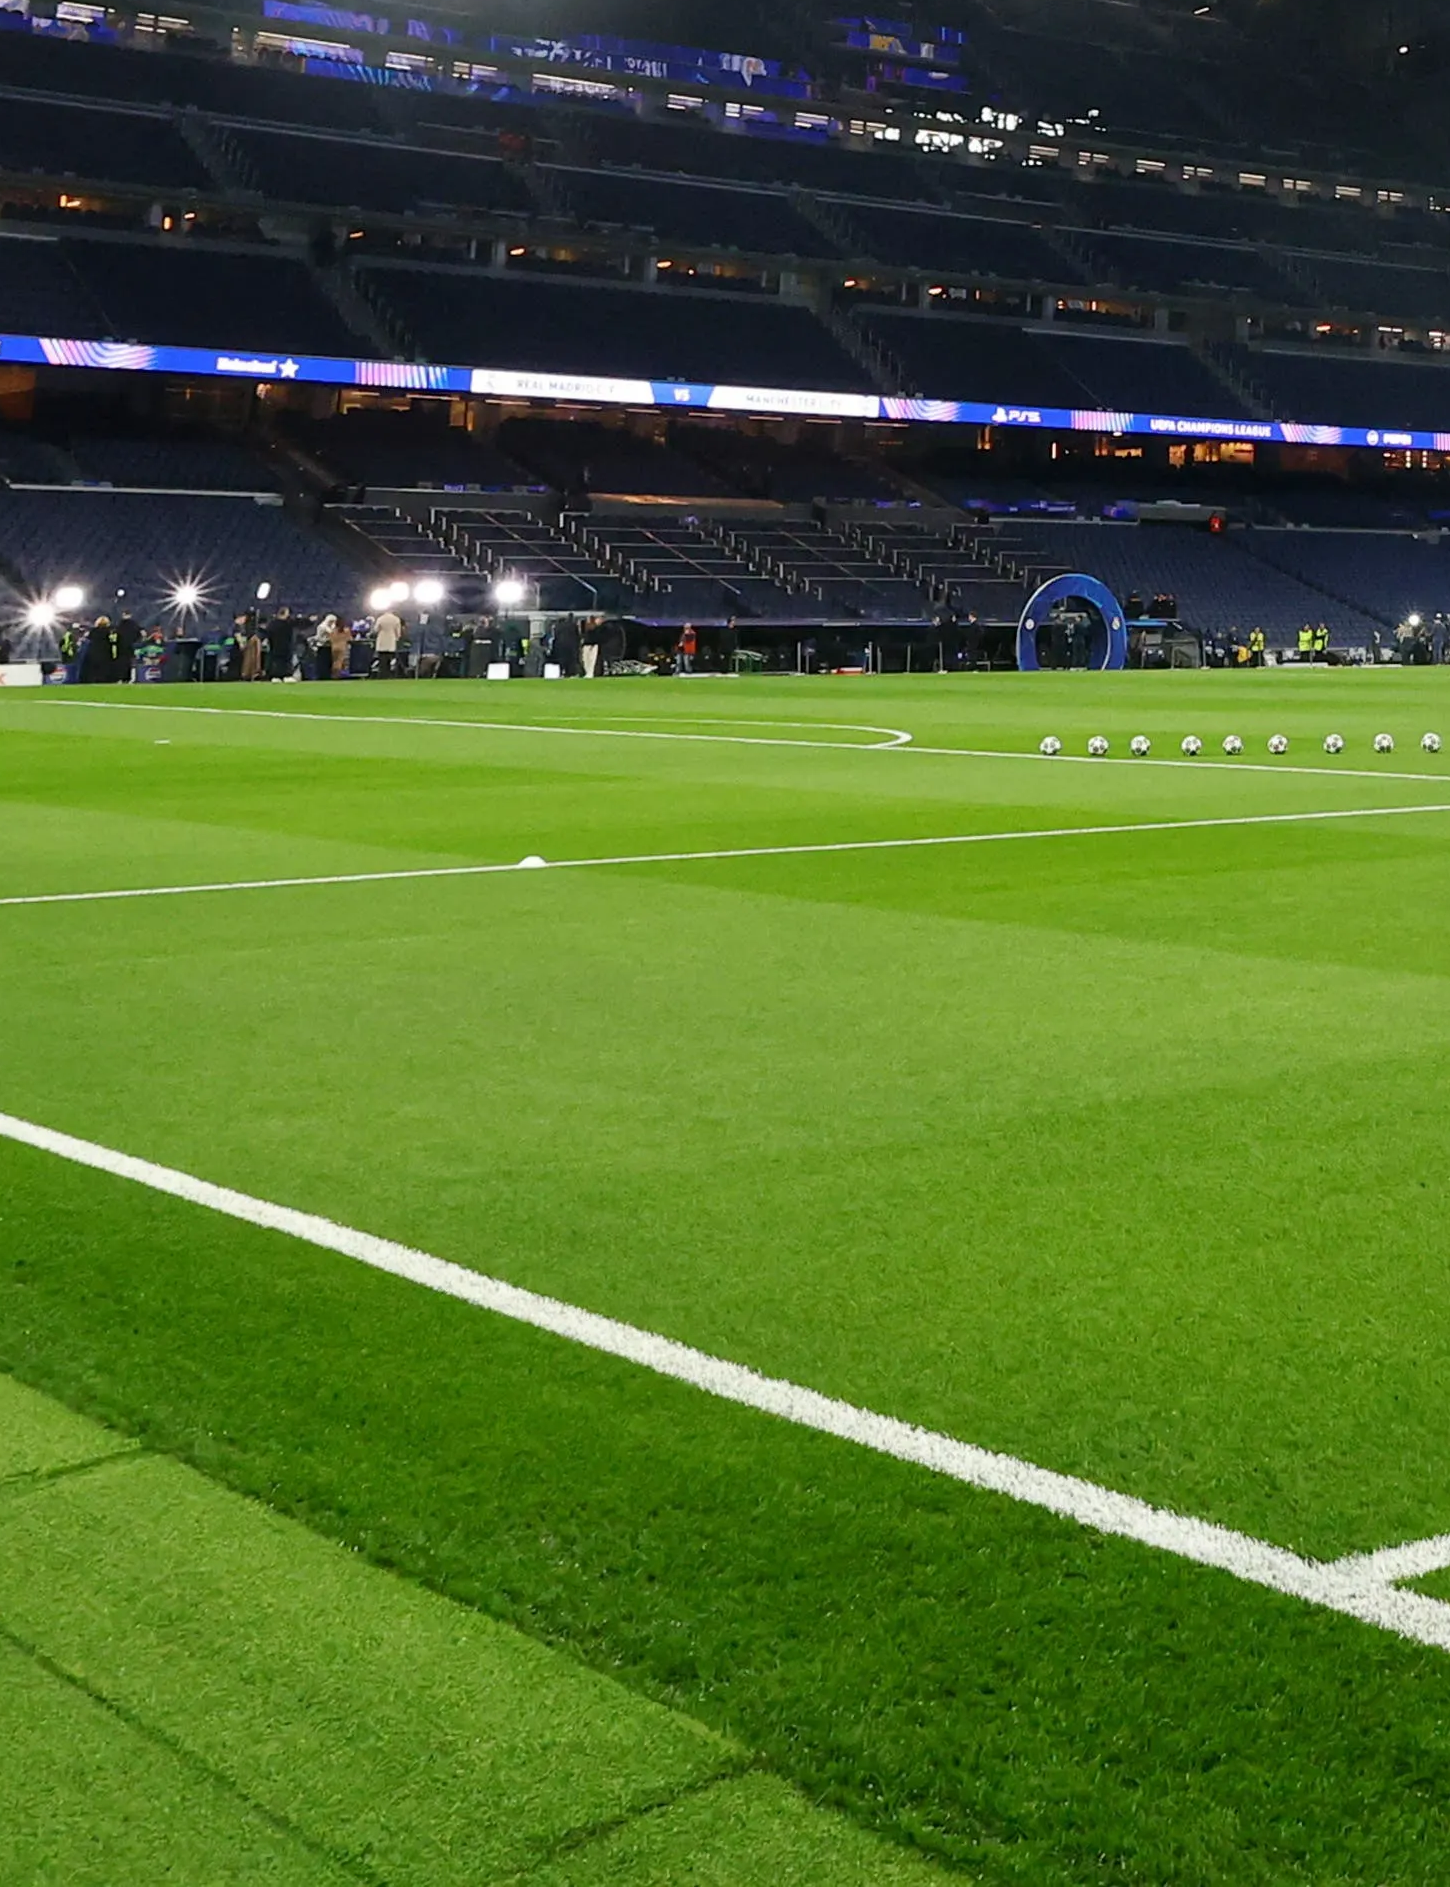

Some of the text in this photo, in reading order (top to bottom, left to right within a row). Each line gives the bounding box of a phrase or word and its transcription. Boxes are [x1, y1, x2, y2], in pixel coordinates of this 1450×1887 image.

[673, 386, 690, 401] VS
[1008, 409, 1042, 423] PS5
[1150, 418, 1272, 438] UEFA CHAMPIONS LEAGUE
